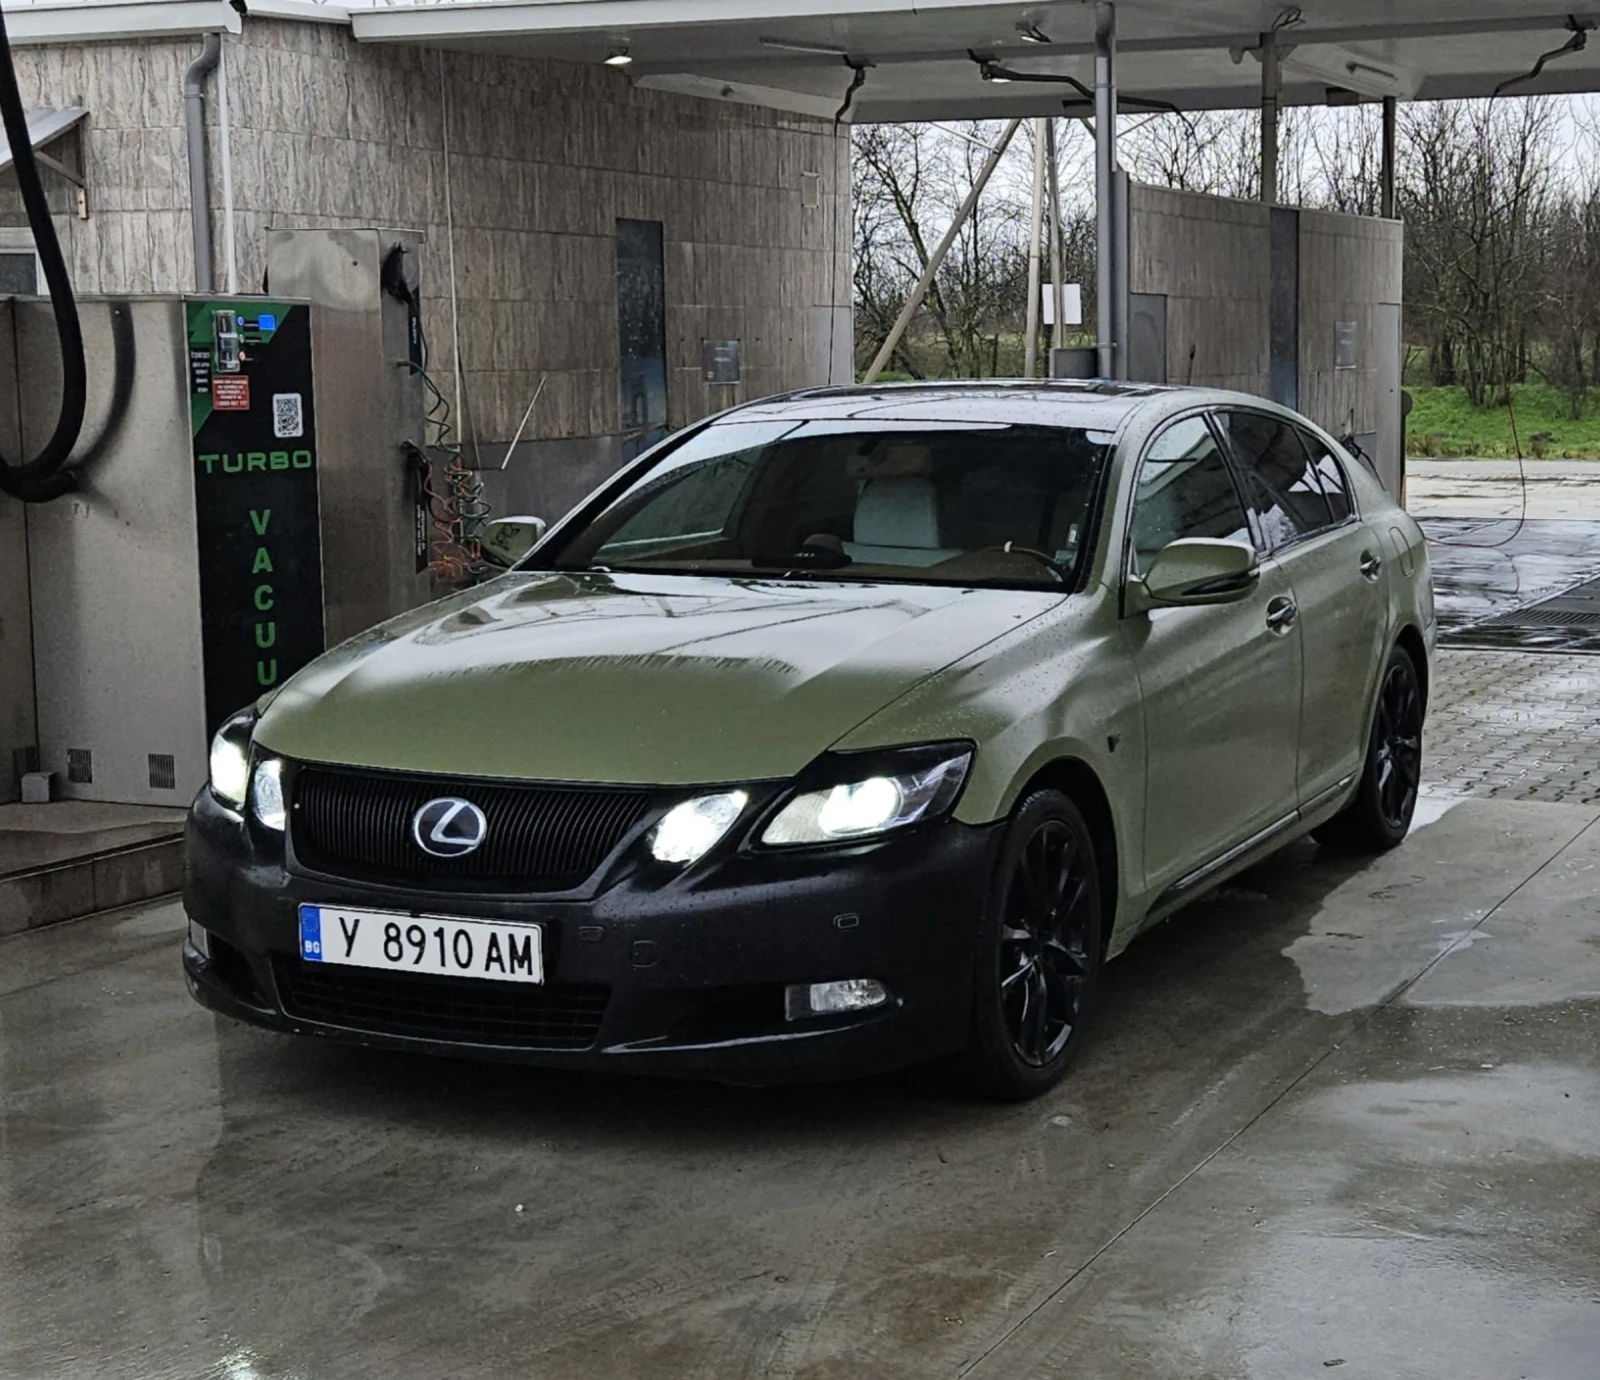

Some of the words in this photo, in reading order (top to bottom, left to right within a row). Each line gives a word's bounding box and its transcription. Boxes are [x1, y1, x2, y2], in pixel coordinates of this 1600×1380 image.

[198, 450, 312, 474] TURBO
[249, 508, 277, 686] VACUU
[304, 939, 321, 954] BG
[383, 921, 474, 970] 8910
[484, 931, 533, 976] AM
